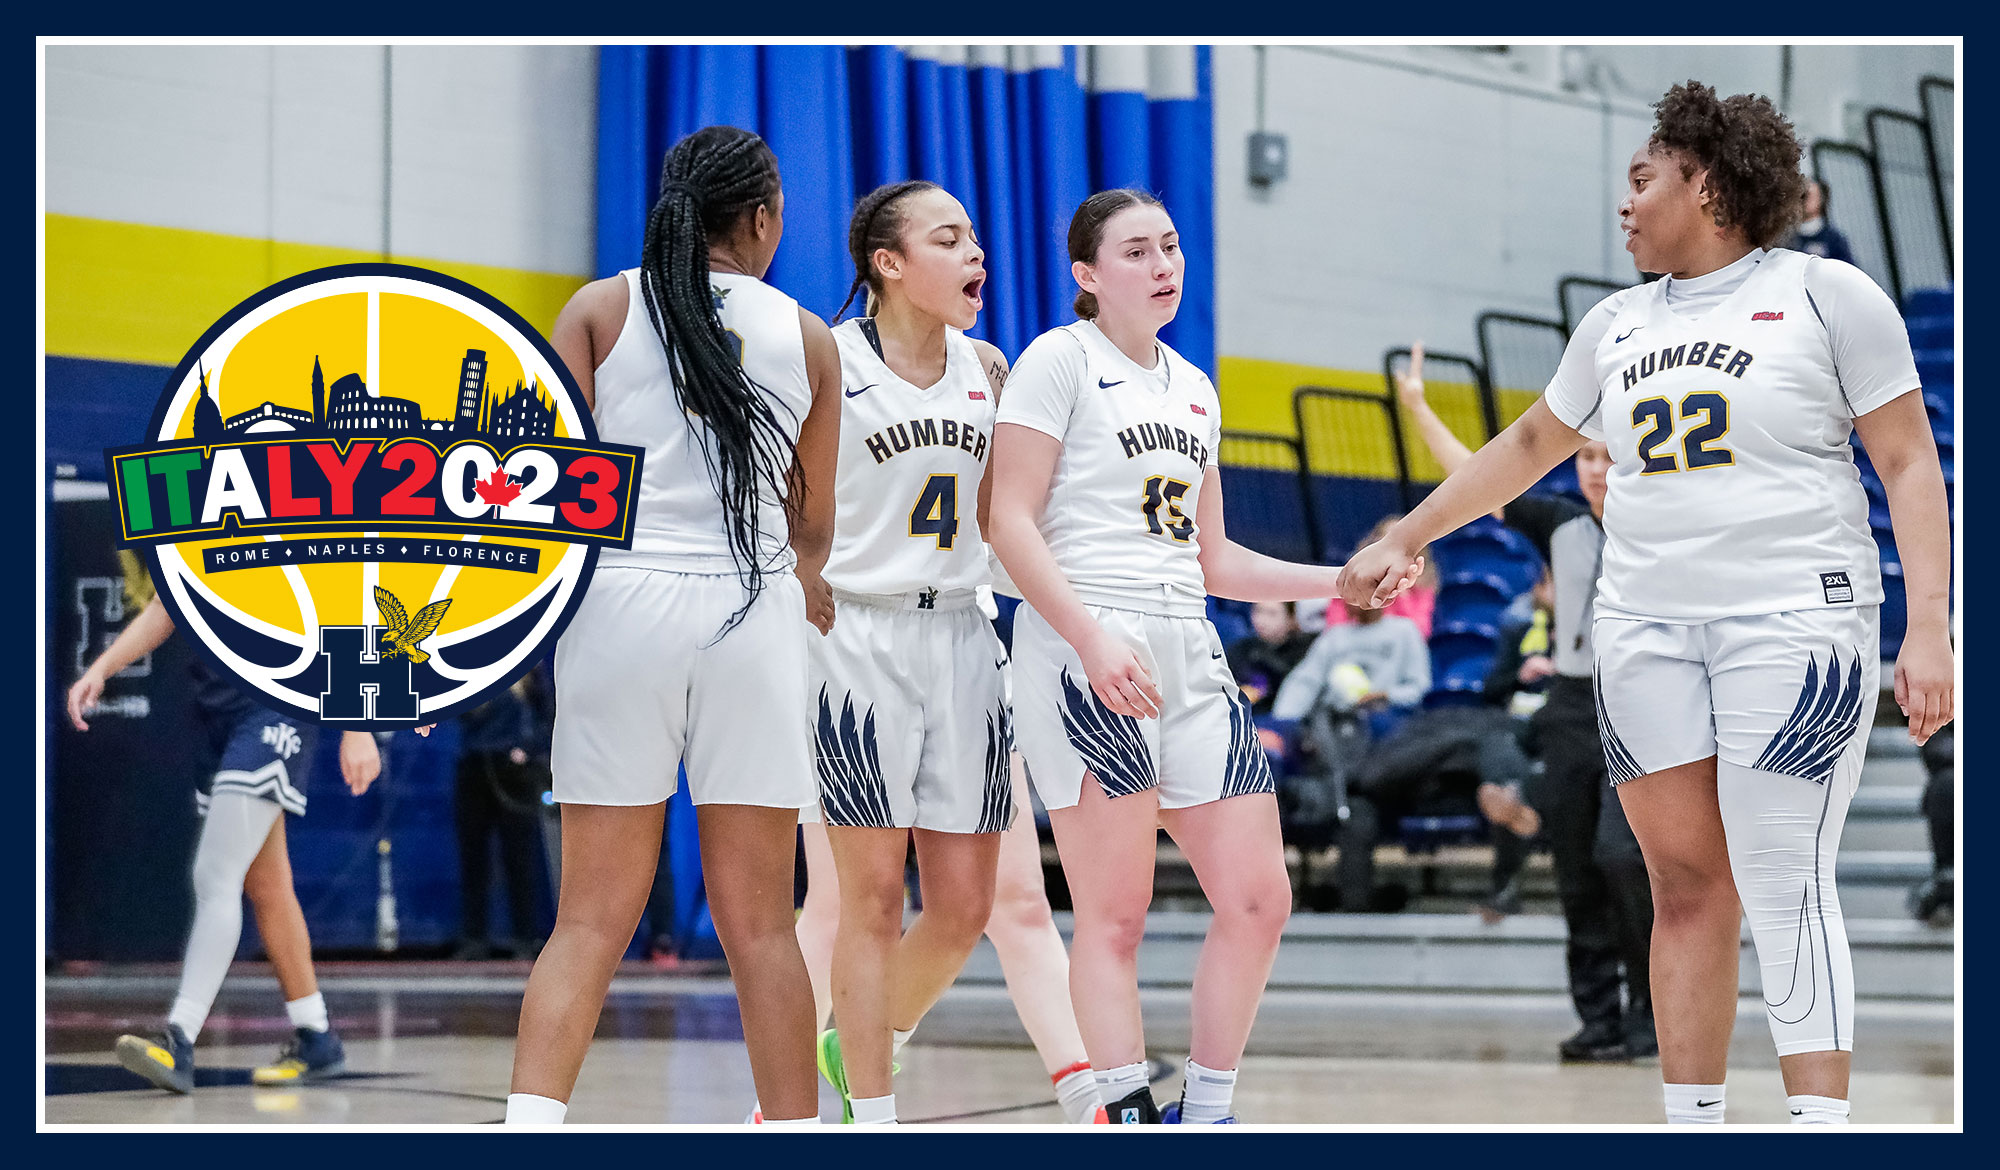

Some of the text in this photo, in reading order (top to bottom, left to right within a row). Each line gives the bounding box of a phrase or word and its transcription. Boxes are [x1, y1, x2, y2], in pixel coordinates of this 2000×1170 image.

[1622, 341, 1754, 392] HUMBER
[864, 418, 988, 464] HUMBER
[1116, 423, 1209, 475] HUMBER
[1630, 390, 1736, 476] 22
[908, 473, 961, 552] 4
[1141, 474, 1196, 543] 15
[1824, 575, 1848, 586] 2XL
